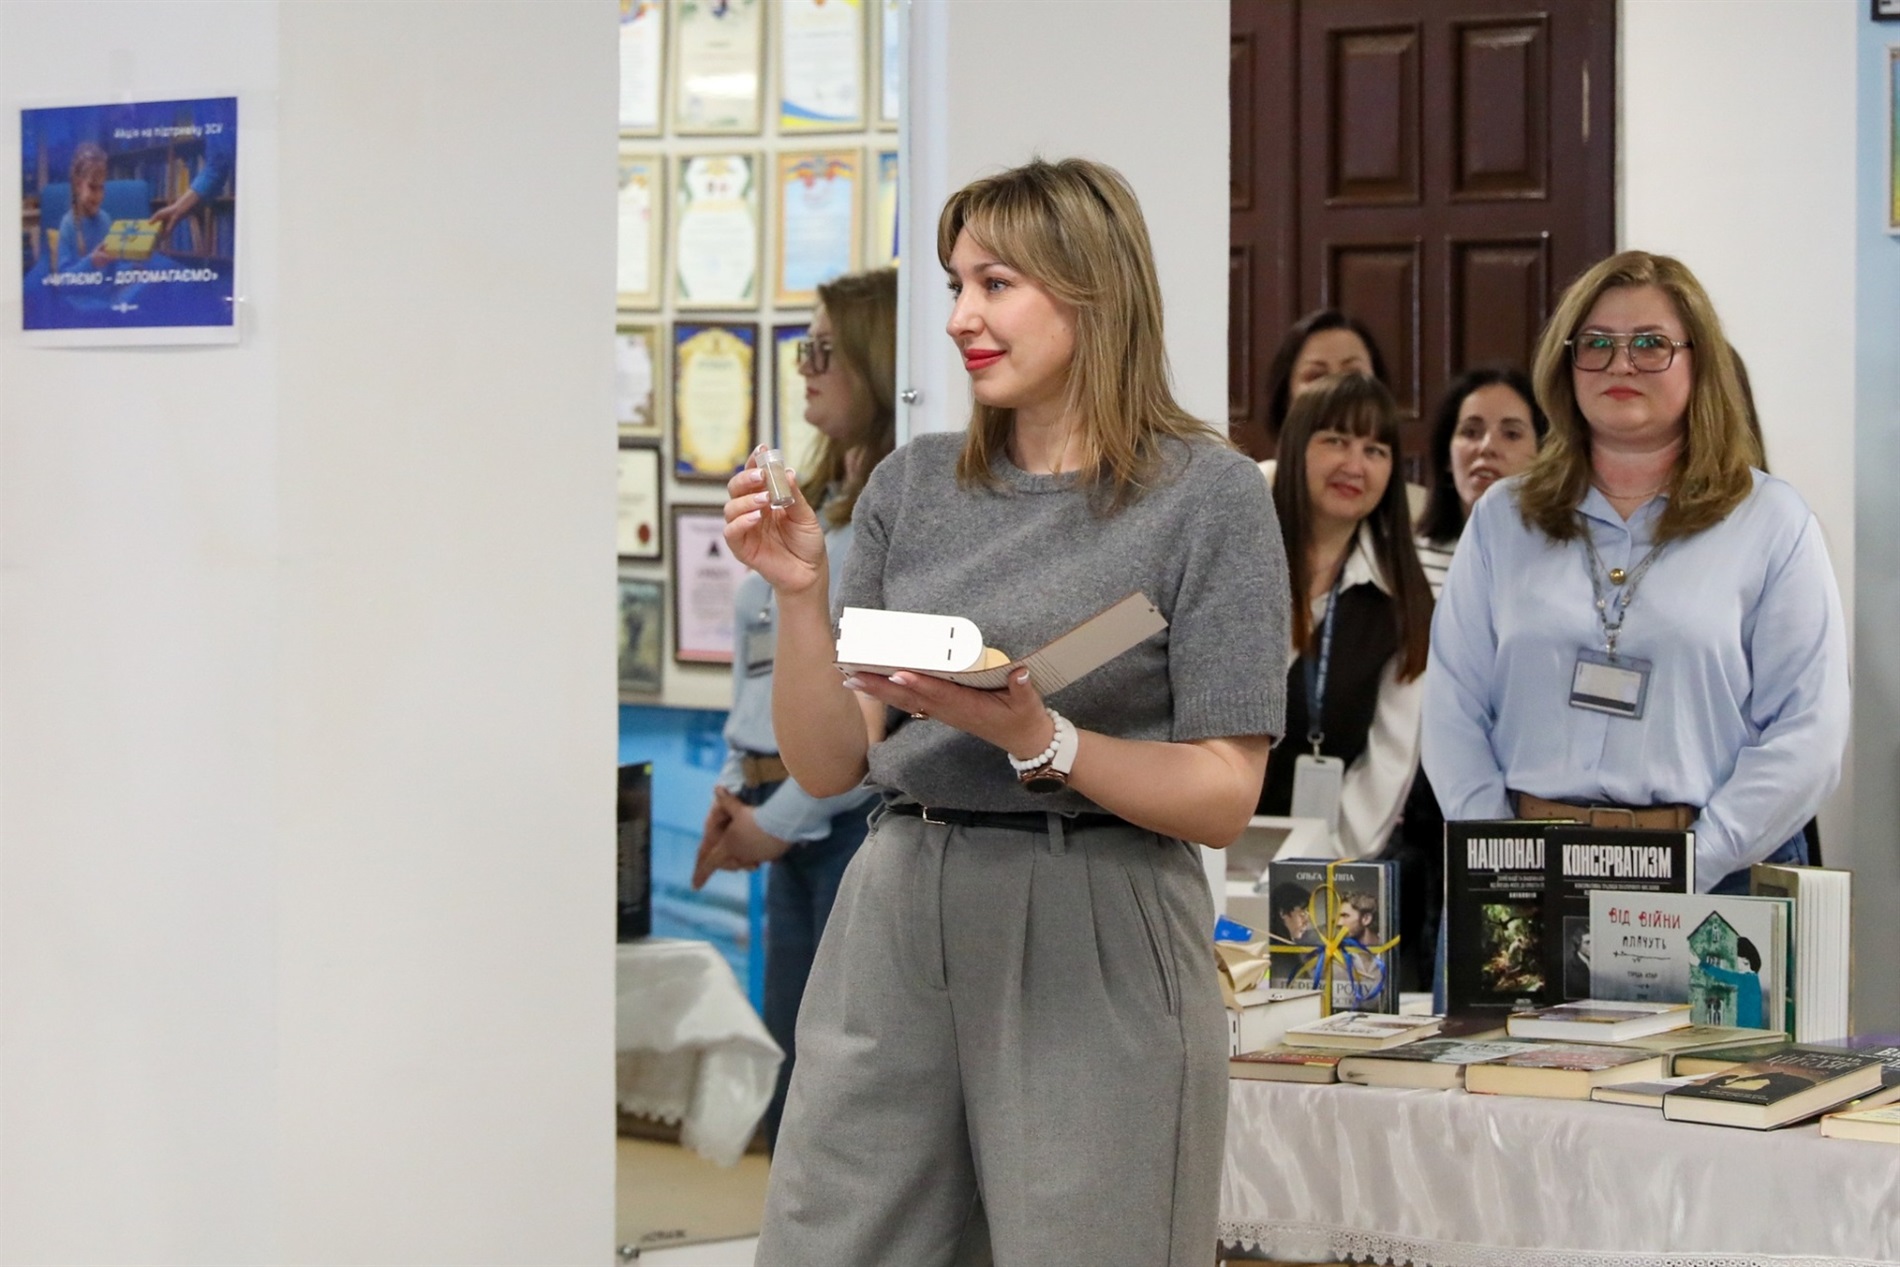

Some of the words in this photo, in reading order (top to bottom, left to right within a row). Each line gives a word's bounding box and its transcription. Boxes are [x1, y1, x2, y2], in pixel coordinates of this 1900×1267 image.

[204, 123, 223, 135] ЗСУ
[1562, 844, 1672, 879] КОНСЕРВАТИЗМ
[1296, 872, 1323, 881] ОЛЬГА
[1609, 907, 1630, 927] ВІД
[1639, 910, 1681, 929] ВІЙНИ
[1622, 935, 1667, 951] ПЛАЧУТЬ
